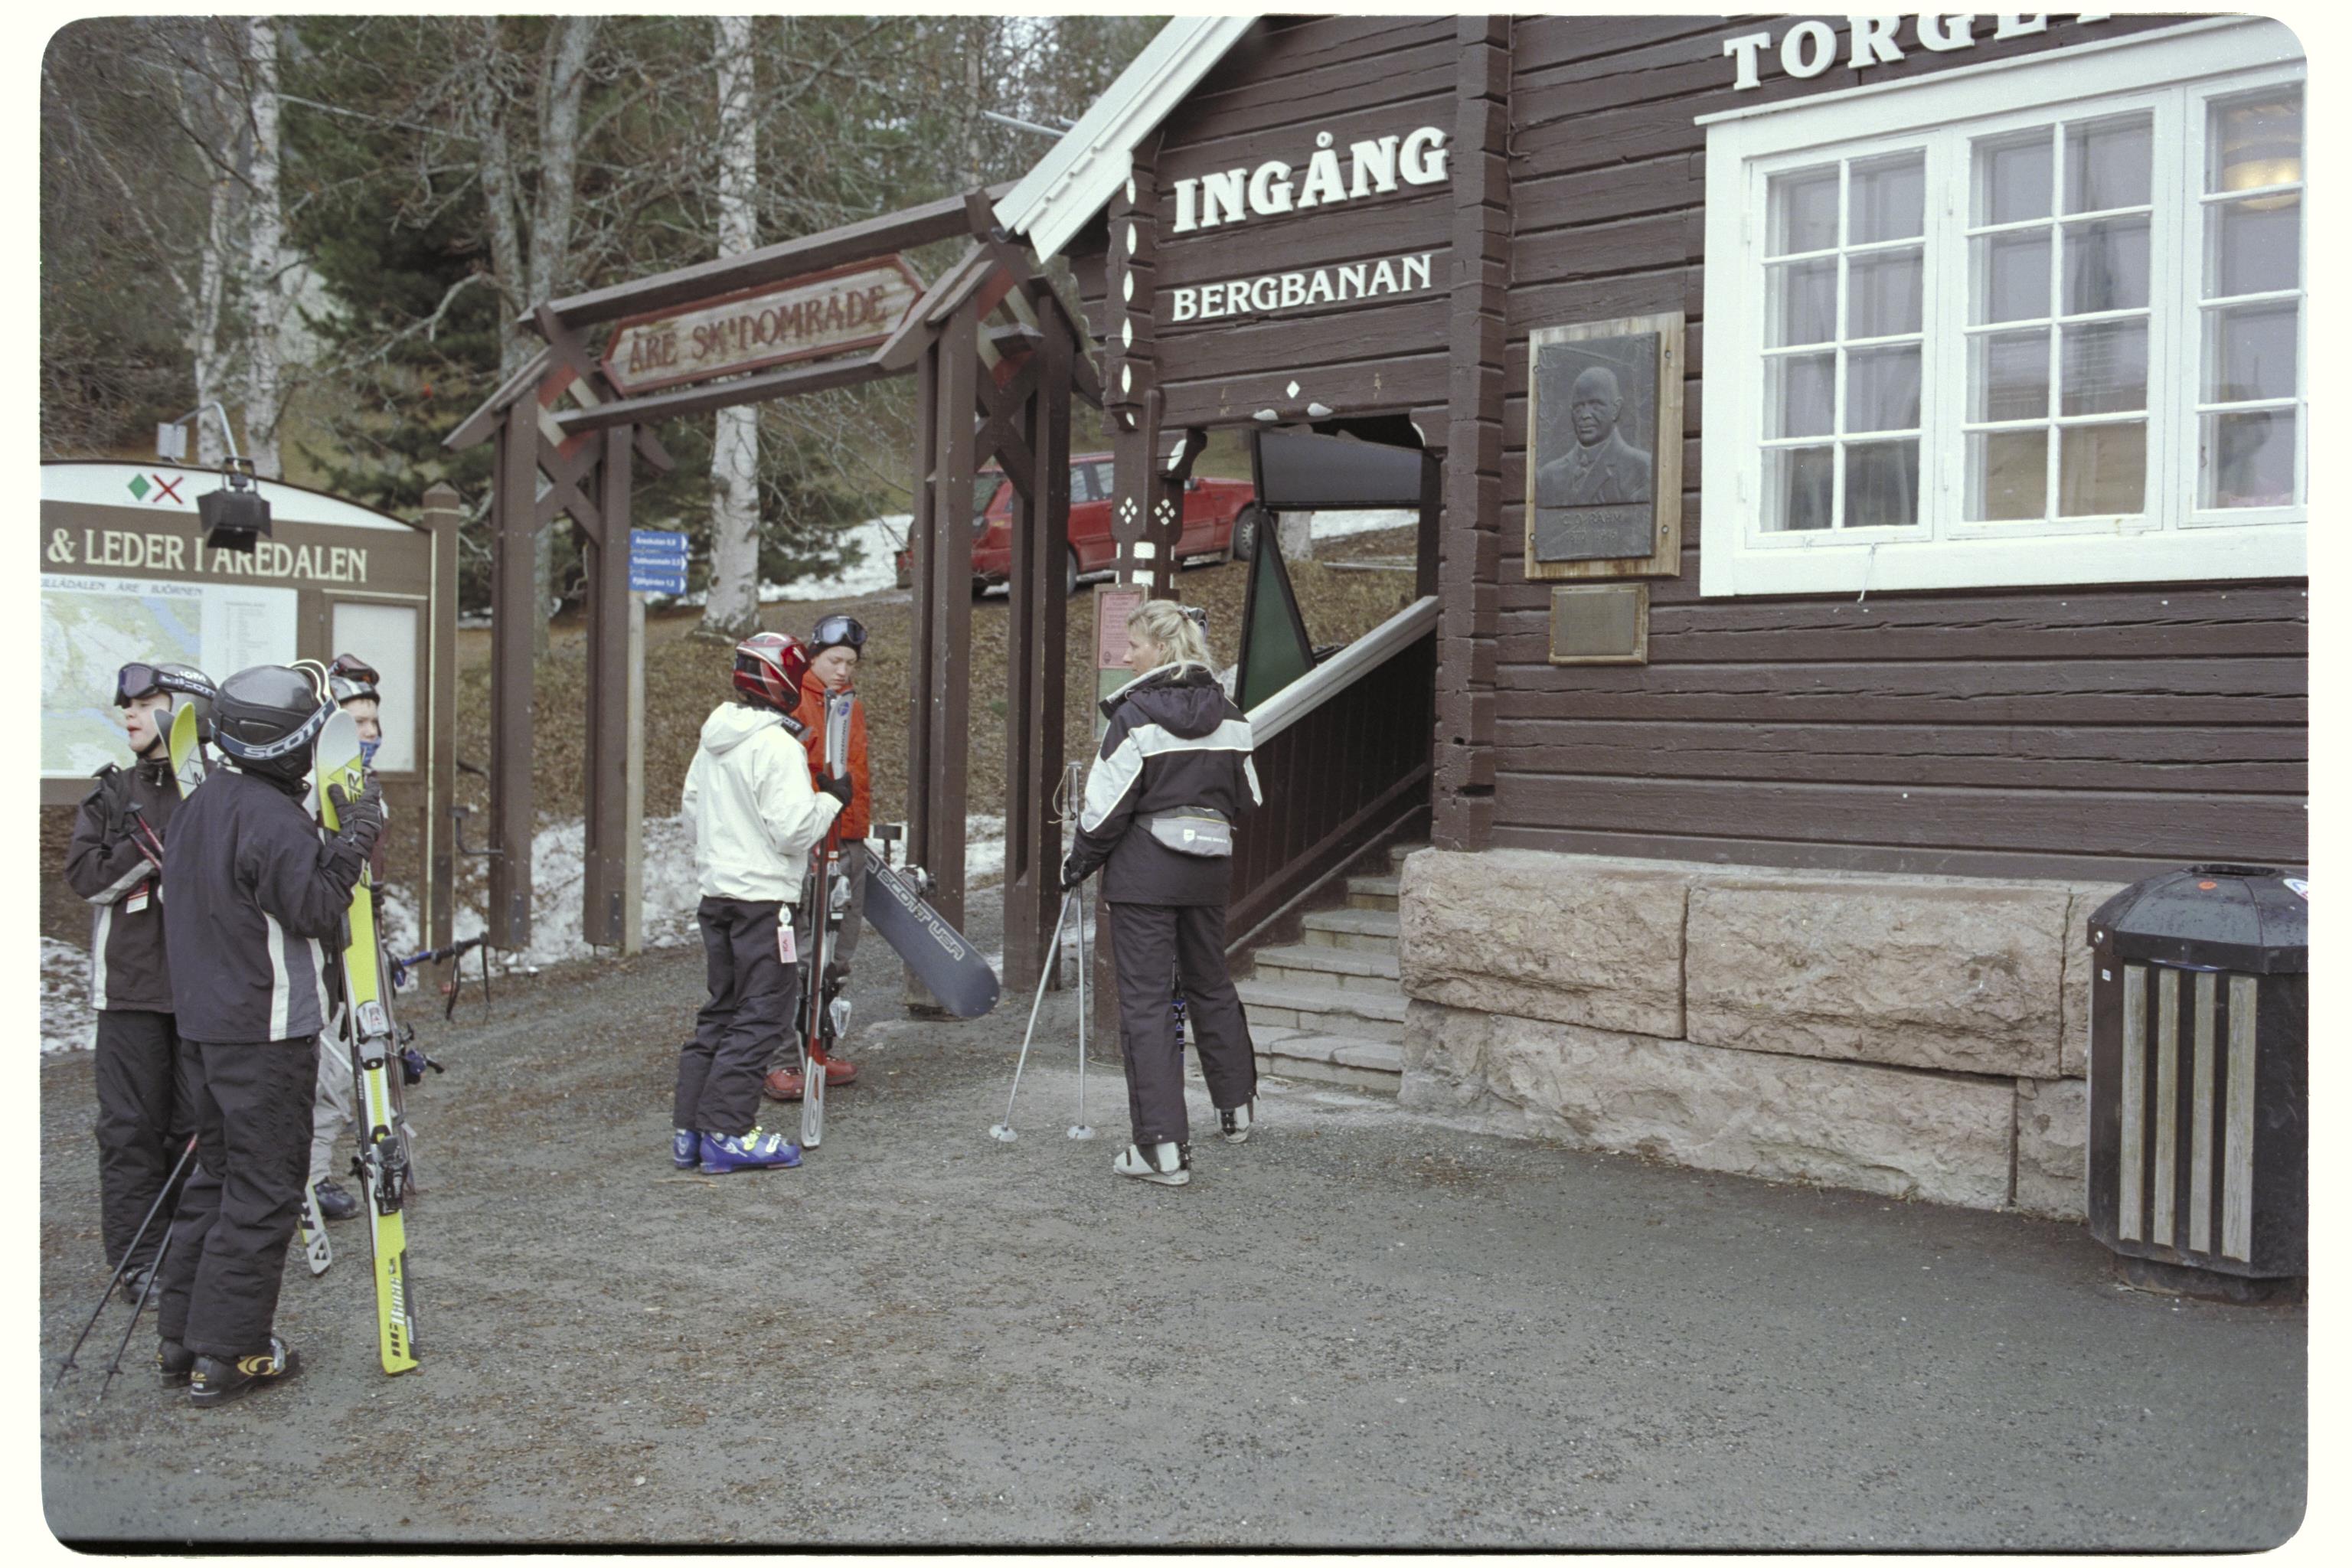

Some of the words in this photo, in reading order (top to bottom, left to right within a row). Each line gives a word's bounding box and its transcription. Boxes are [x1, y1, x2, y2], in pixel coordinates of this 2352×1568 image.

[1723, 15, 2111, 90] TORG
[1172, 126, 1449, 233] INGÅNG
[1172, 253, 1432, 322] BERGBANAN
[628, 329, 679, 373] ÅRE
[47, 528, 76, 564] &
[84, 528, 185, 571] LEDER
[194, 537, 204, 572] I
[243, 707, 327, 759] SCOTT
[876, 867, 933, 923] SCOTT
[927, 920, 965, 962] USA
